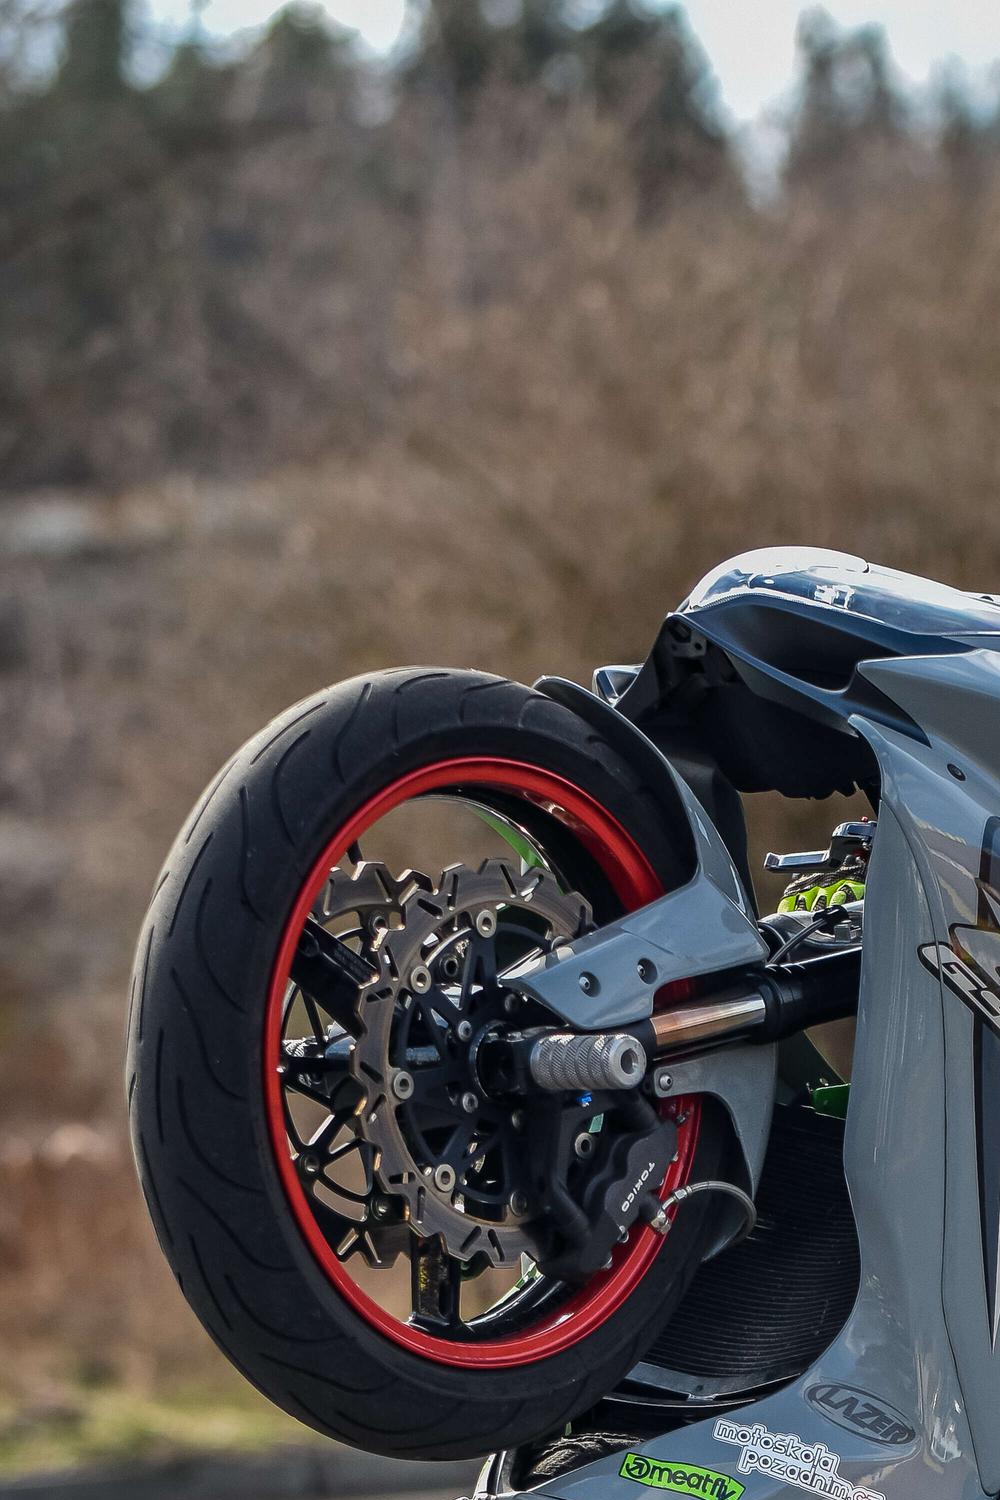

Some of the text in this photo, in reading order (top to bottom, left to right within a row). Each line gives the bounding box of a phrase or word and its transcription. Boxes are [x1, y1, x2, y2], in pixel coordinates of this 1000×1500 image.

[621, 1162, 656, 1212] TOKICO
[819, 1386, 908, 1443] LAZER
[715, 1422, 836, 1473] motoškola
